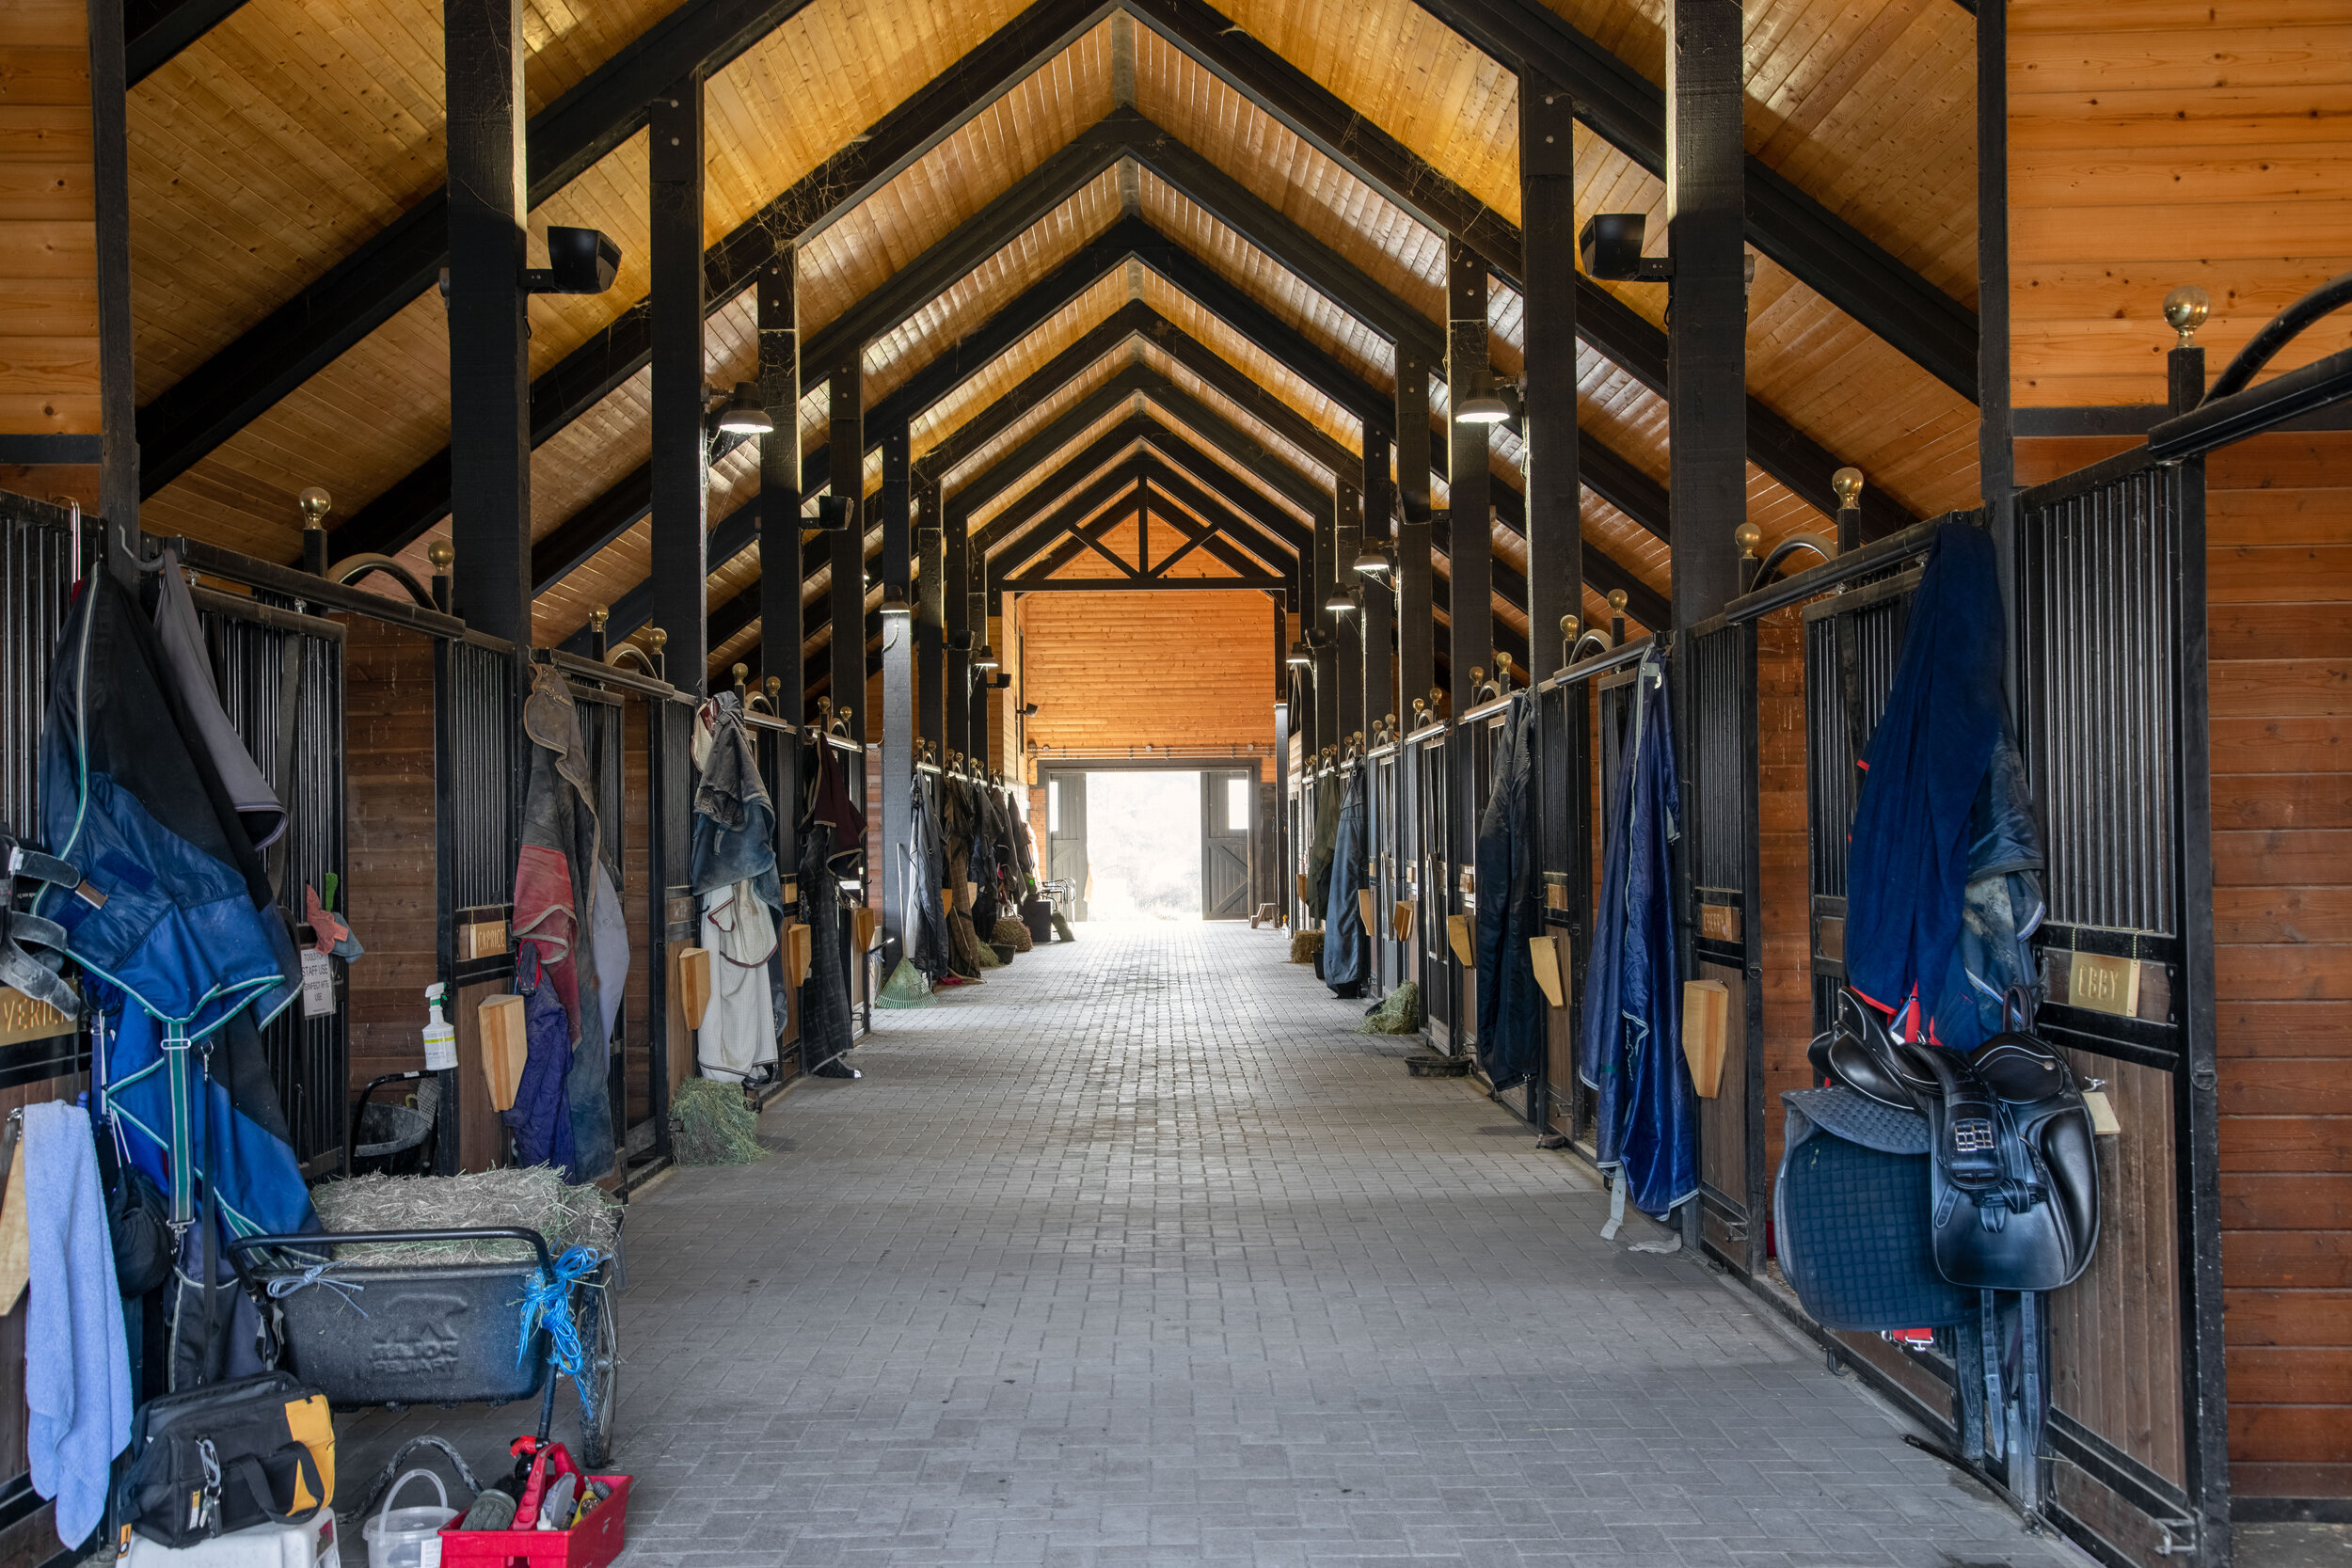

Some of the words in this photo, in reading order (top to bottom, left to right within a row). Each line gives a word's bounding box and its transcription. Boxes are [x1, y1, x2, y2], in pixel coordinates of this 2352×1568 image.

[478, 928, 504, 950] CAPRICE
[304, 953, 316, 961] TOOLS
[302, 965, 318, 977] STAFF
[319, 964, 328, 975] USE
[304, 981, 321, 991] SINFECT
[2078, 964, 2120, 1002] EBBY
[314, 992, 323, 1002] USE
